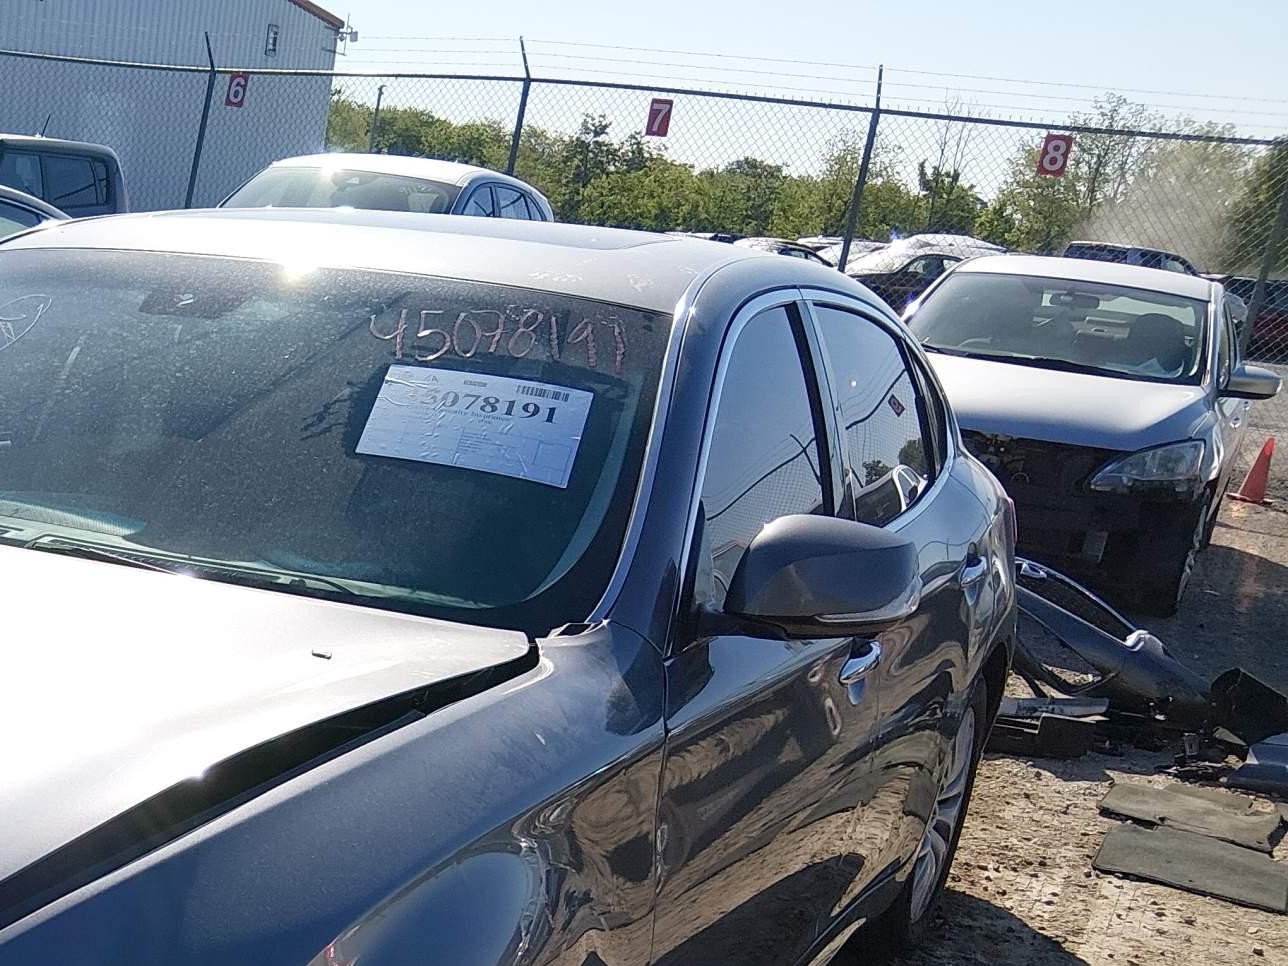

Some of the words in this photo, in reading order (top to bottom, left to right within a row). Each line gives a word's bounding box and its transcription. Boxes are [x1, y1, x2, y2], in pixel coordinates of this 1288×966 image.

[229, 77, 246, 103] 6
[652, 103, 671, 132] 7
[1042, 139, 1067, 171] 8
[370, 309, 627, 374] 45078191
